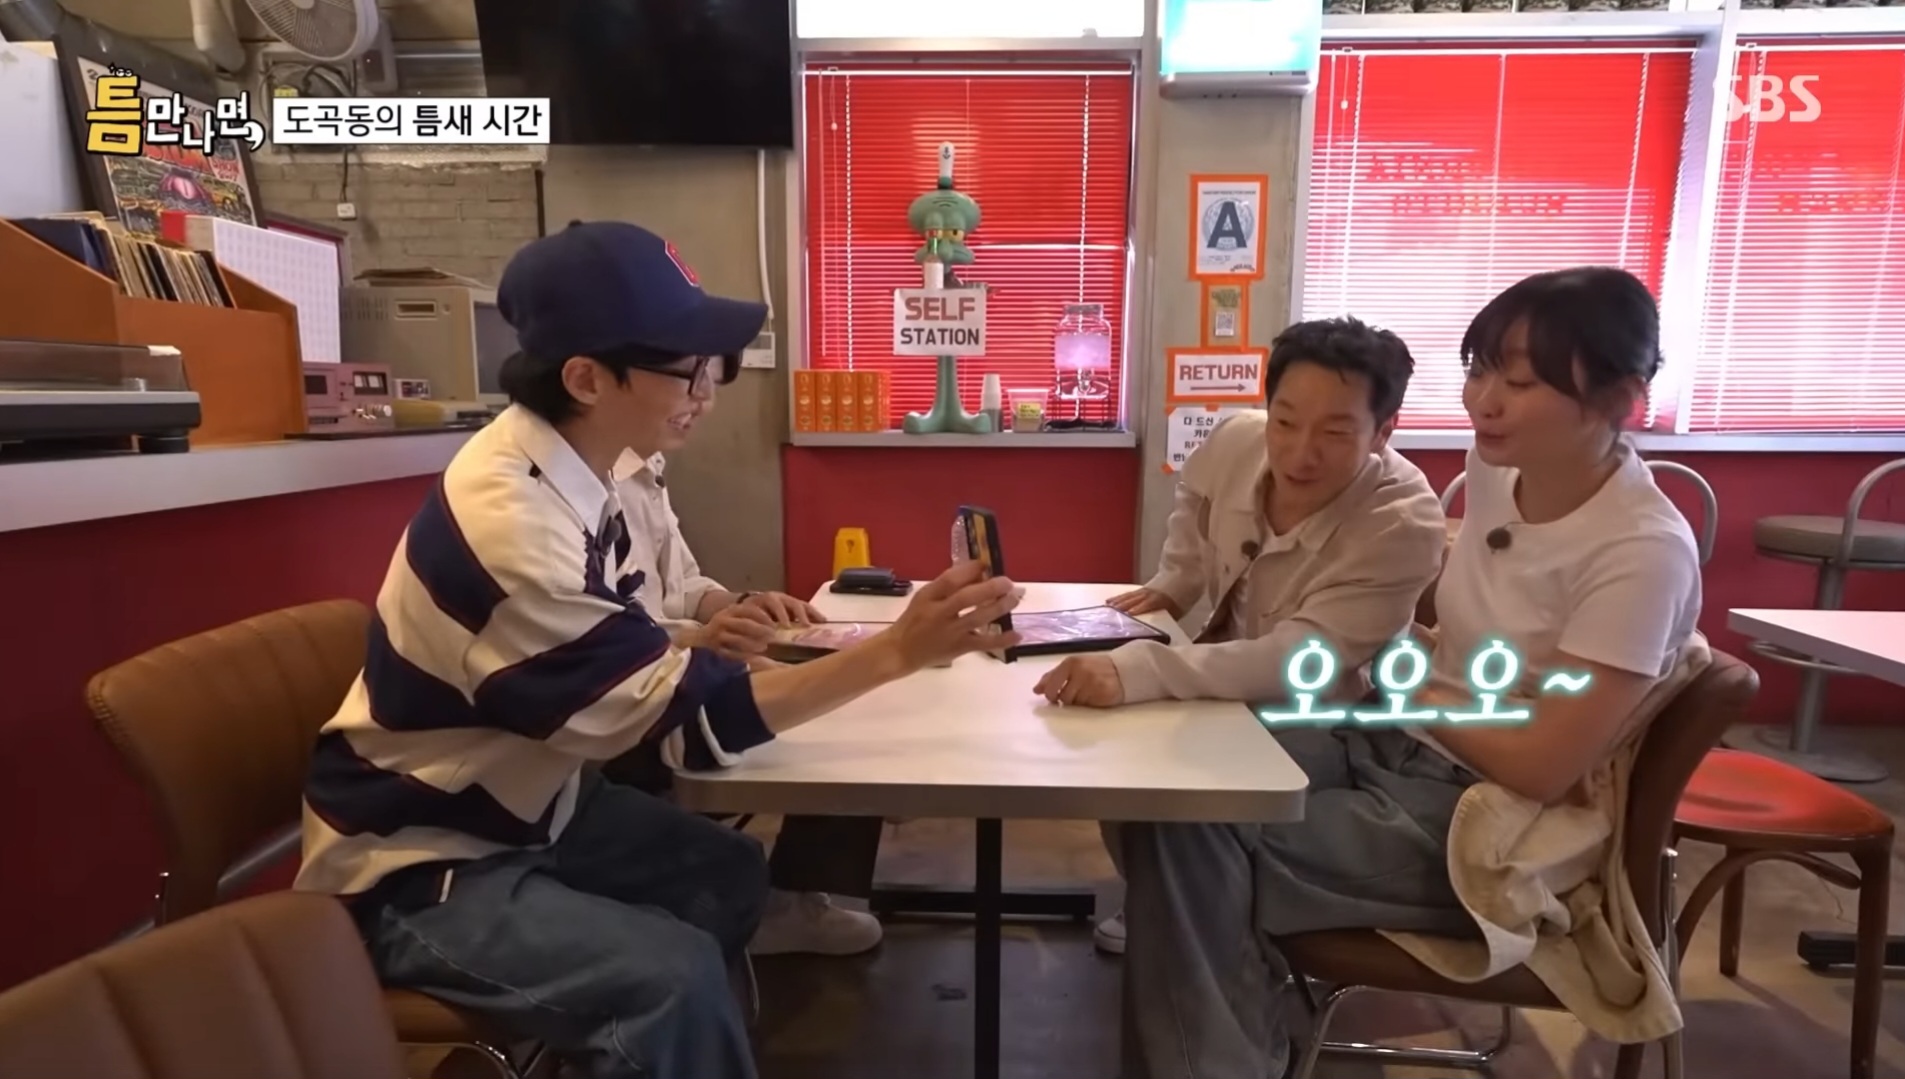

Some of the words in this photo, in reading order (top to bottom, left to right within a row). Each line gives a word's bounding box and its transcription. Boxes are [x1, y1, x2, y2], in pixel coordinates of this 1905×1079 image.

[1206, 200, 1248, 248] A
[904, 297, 975, 321] SELF
[900, 328, 980, 346] STATION
[1179, 363, 1258, 381] RETURN
